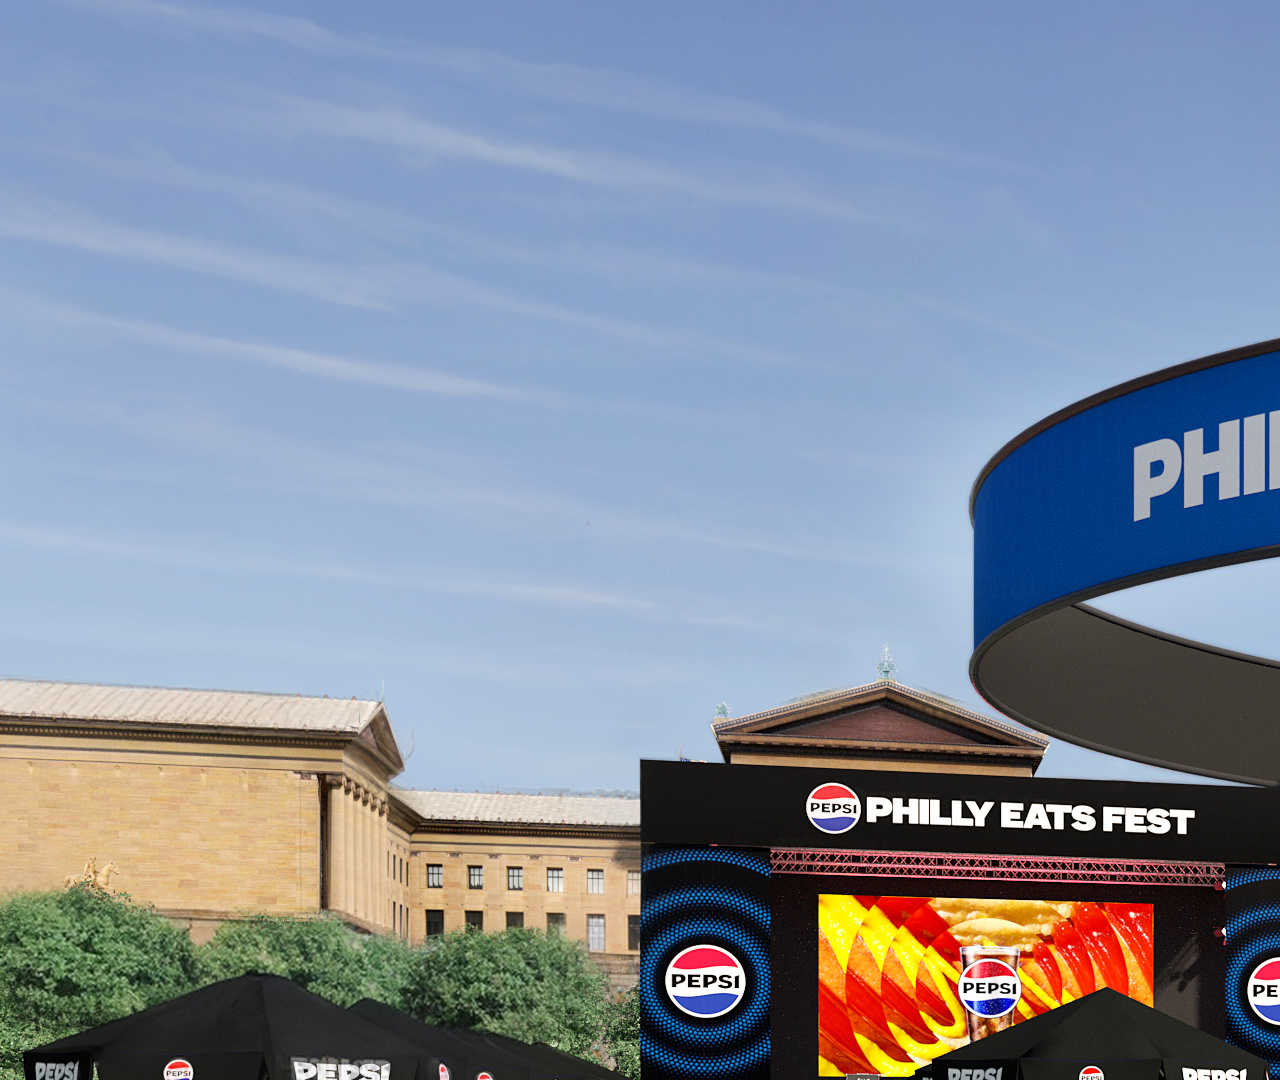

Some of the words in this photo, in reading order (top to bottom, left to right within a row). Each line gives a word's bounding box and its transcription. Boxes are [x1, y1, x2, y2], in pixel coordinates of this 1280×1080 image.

[811, 801, 857, 814] PEPSI
[866, 796, 995, 827] PHILLY
[1000, 801, 1097, 832] EATS
[1102, 806, 1196, 835] FEST
[671, 973, 740, 989] PEPSI
[963, 982, 1017, 995] PEPSI
